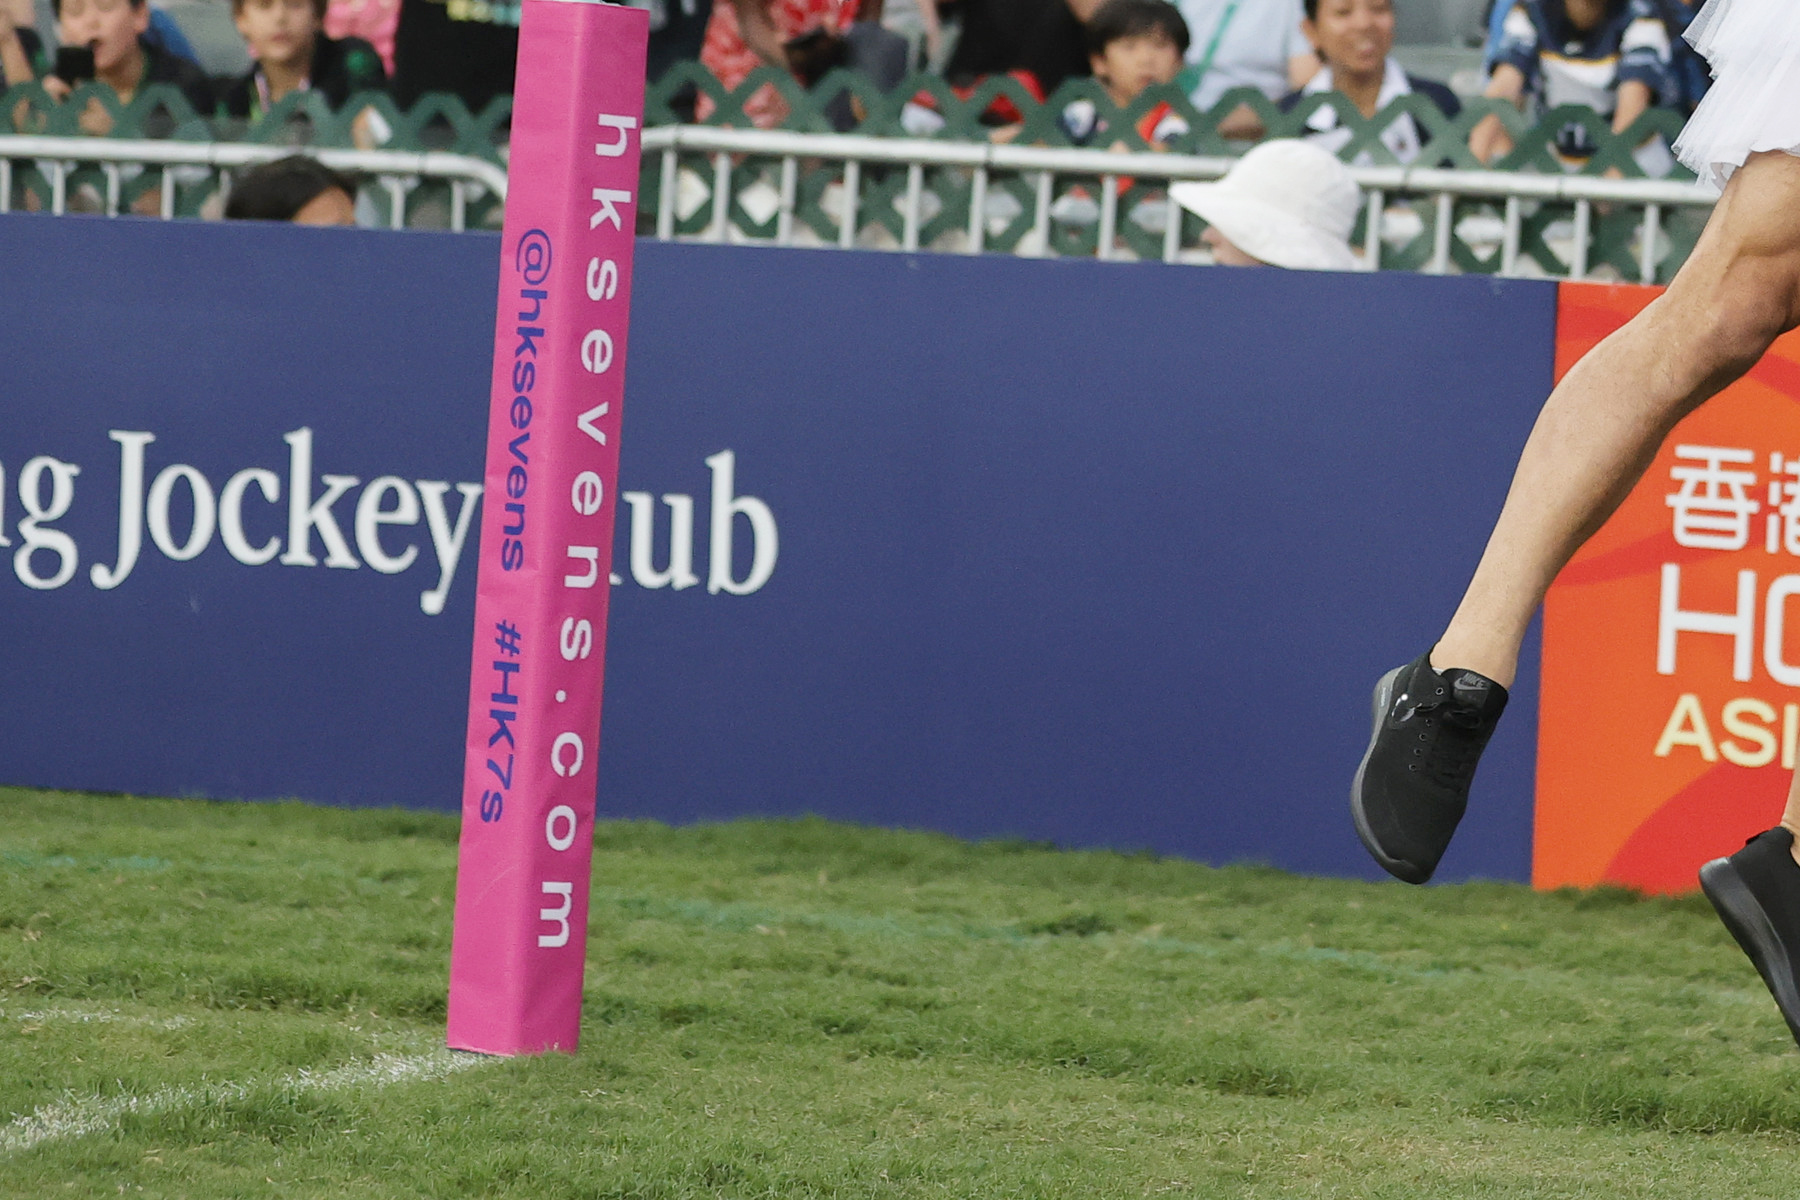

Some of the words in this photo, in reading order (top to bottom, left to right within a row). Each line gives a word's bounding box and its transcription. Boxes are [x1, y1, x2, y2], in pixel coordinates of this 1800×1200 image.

[90, 427, 484, 615] Jockey
[502, 228, 553, 572] @hksevens
[538, 112, 637, 948] hksevens.com
[480, 619, 522, 824] #HK7s
